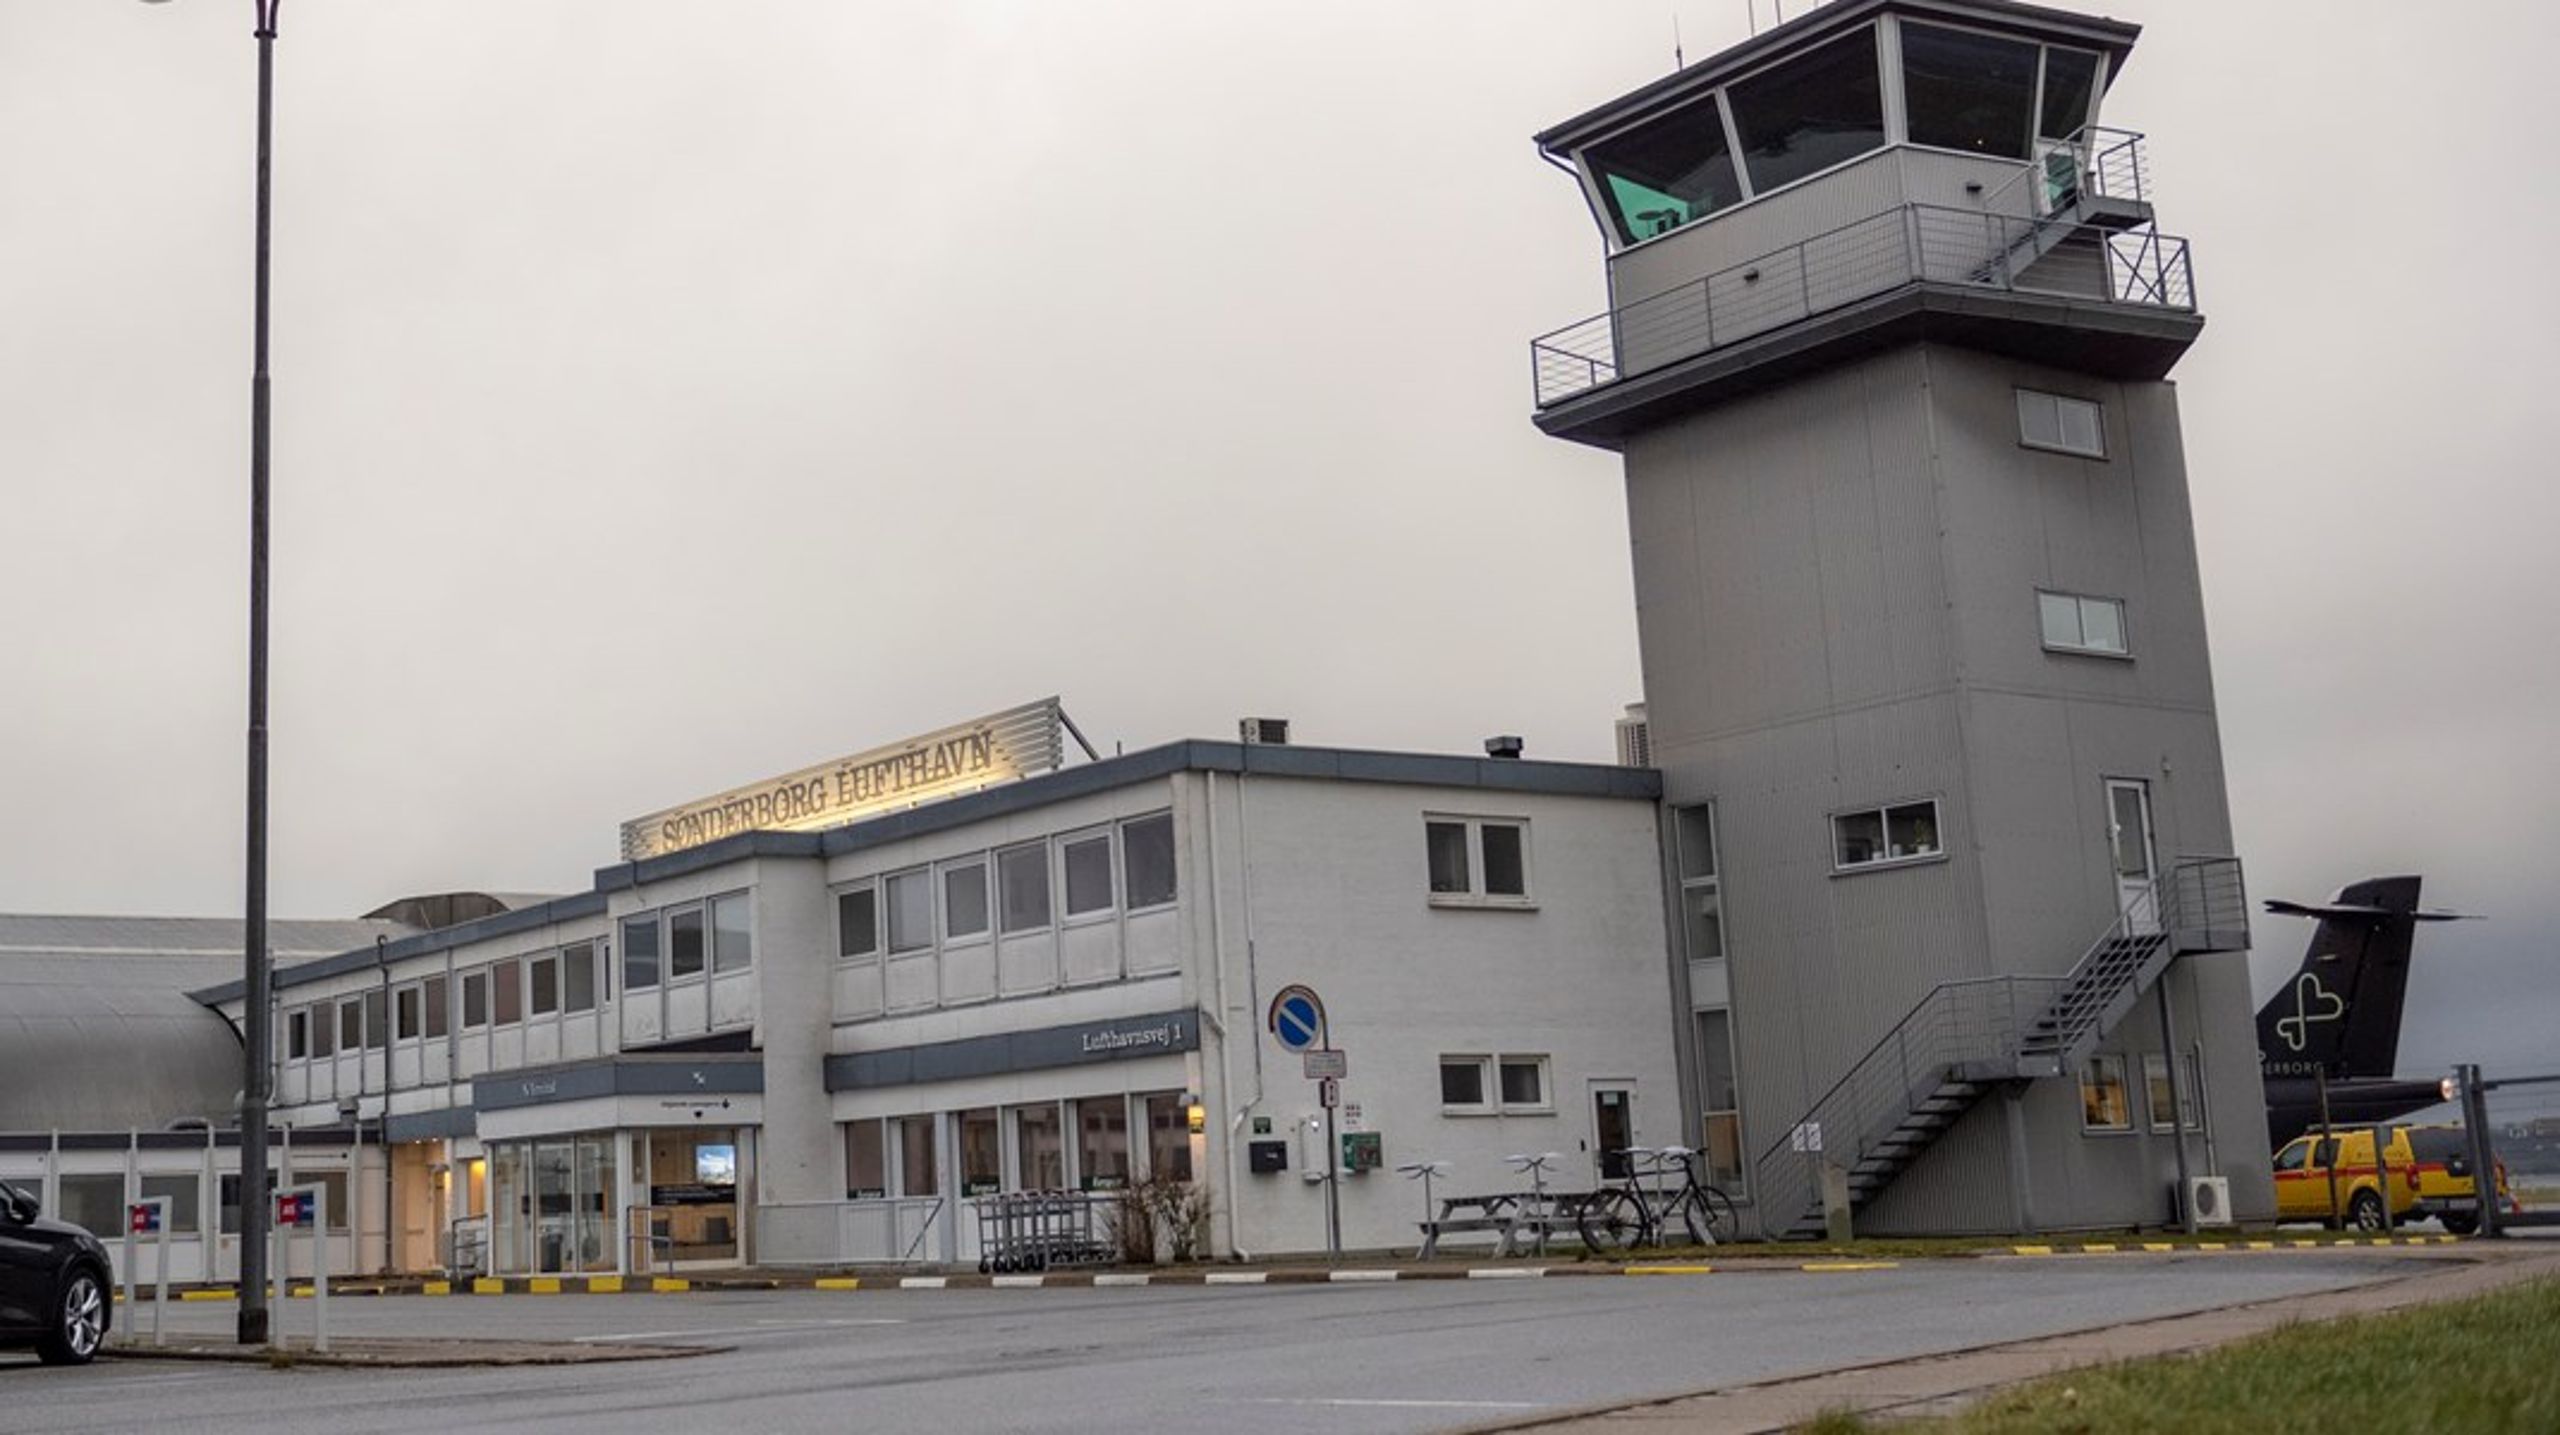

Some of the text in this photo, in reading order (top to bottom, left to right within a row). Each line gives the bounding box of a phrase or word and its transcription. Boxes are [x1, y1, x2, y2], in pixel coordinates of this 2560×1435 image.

[661, 730, 992, 849] SØNDERBORG LUFTHAVN
[1083, 1023, 1182, 1051] Lufthavnsvej 1
[2264, 1061, 2324, 1075] ERBORG
